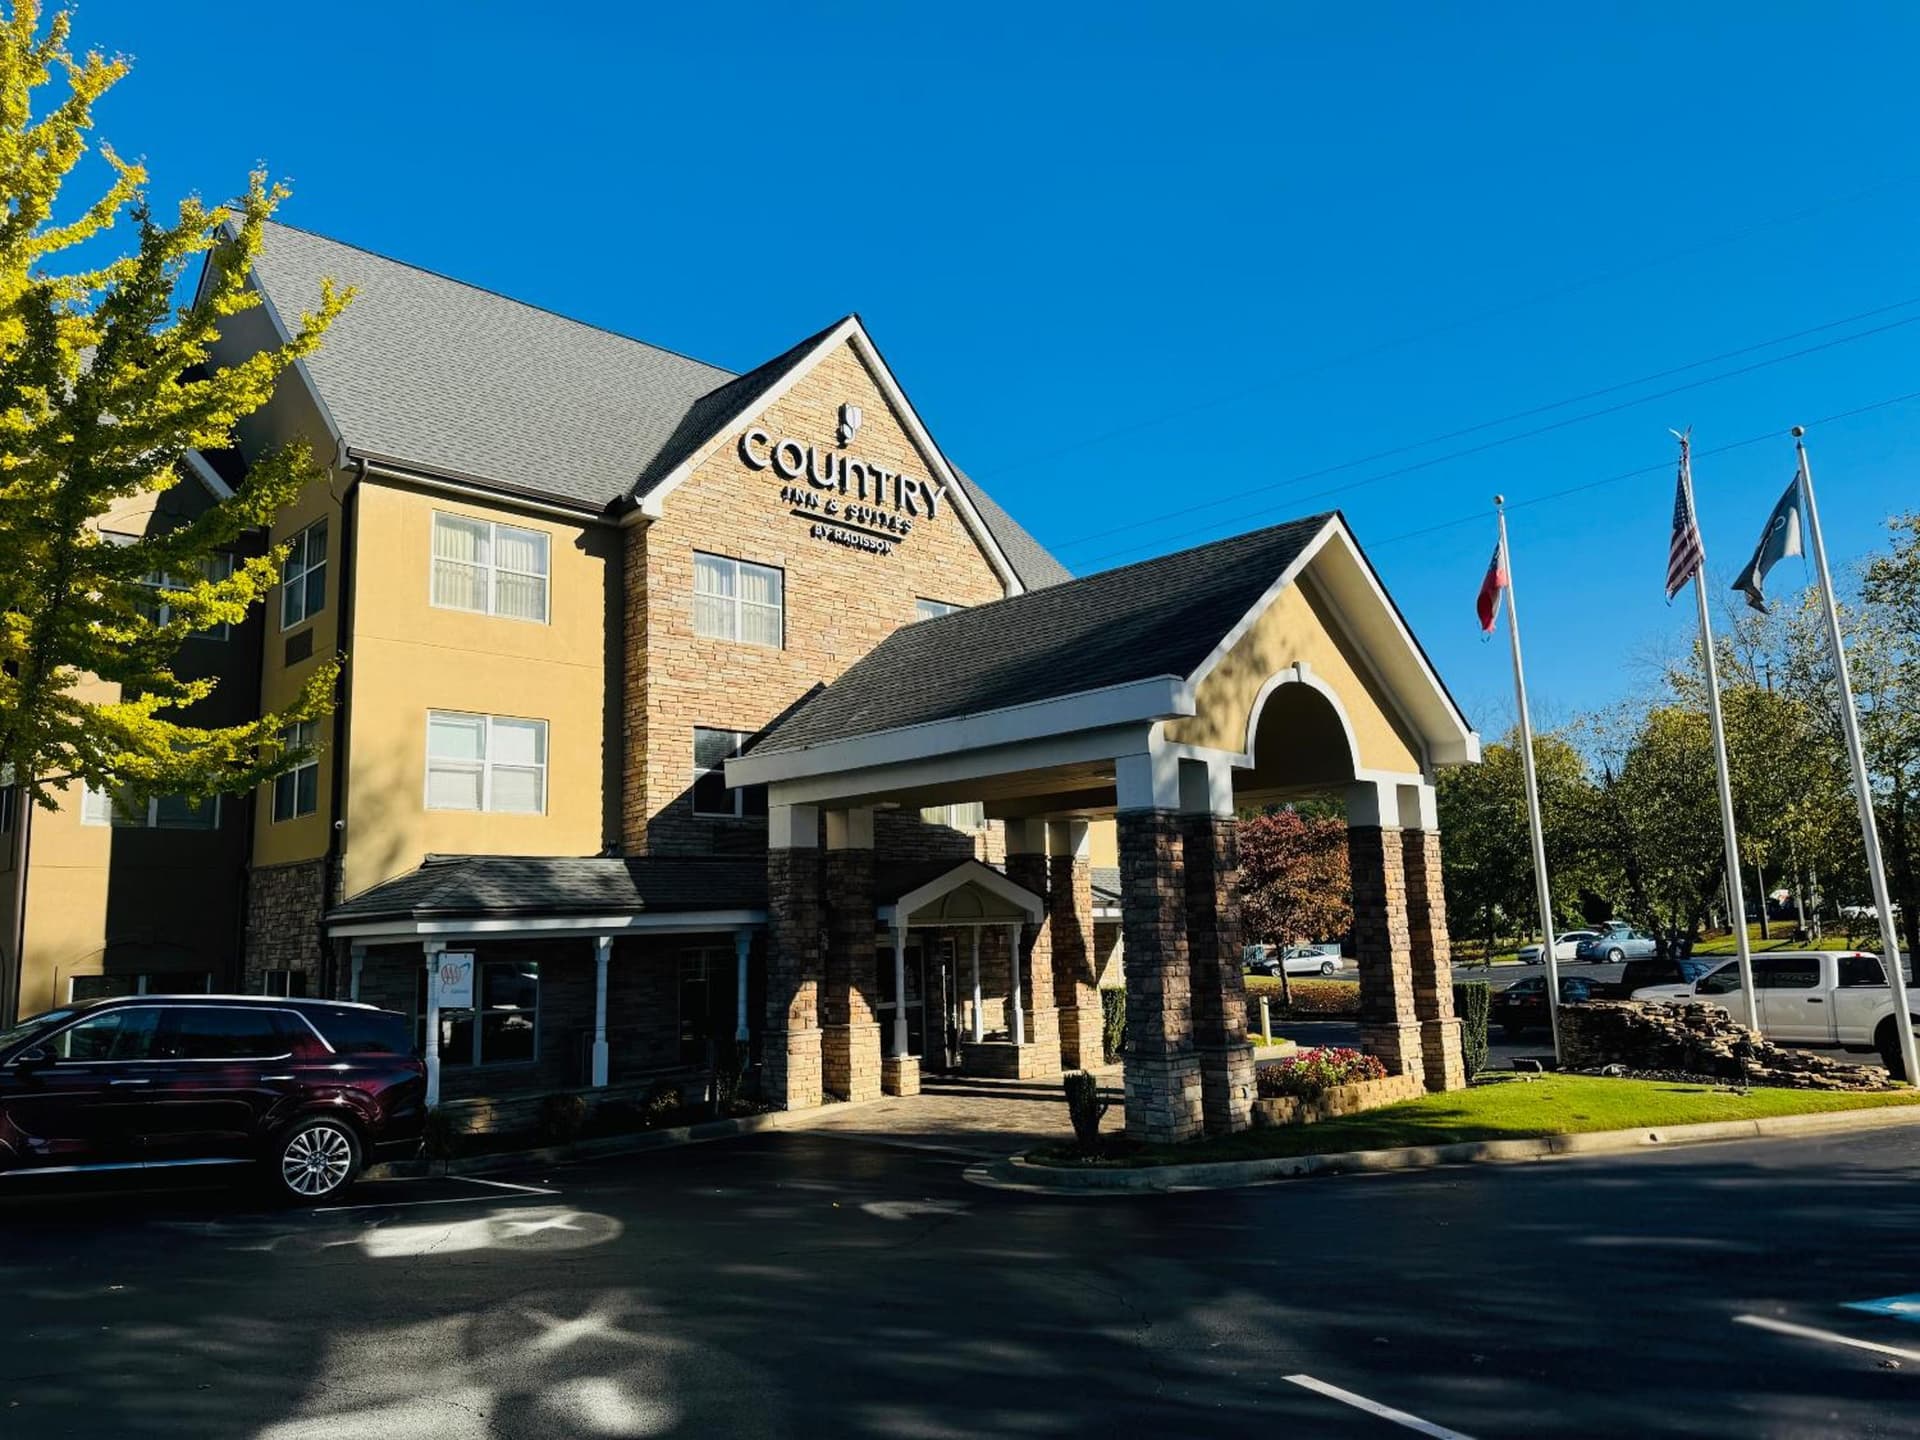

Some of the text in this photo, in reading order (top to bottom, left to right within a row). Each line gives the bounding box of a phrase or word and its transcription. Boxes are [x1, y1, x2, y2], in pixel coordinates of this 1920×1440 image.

[781, 487, 914, 534] INN & SUITES
[811, 524, 894, 555] BY RADISSON
